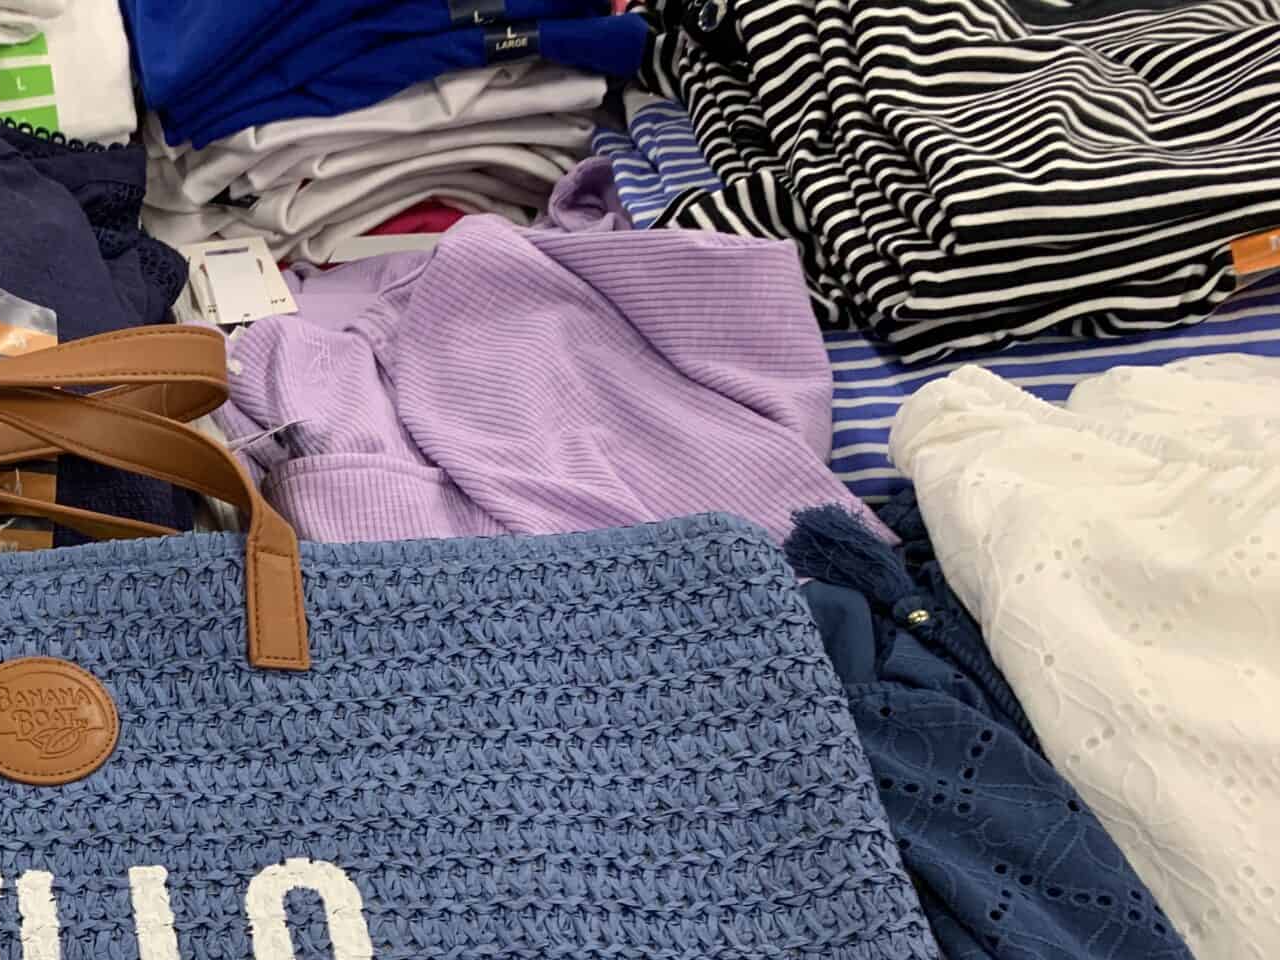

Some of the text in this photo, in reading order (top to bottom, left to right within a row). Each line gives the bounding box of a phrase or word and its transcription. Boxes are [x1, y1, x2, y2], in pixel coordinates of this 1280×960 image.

[507, 26, 517, 38] L
[16, 75, 27, 91] L
[11, 707, 78, 736] BOAT
